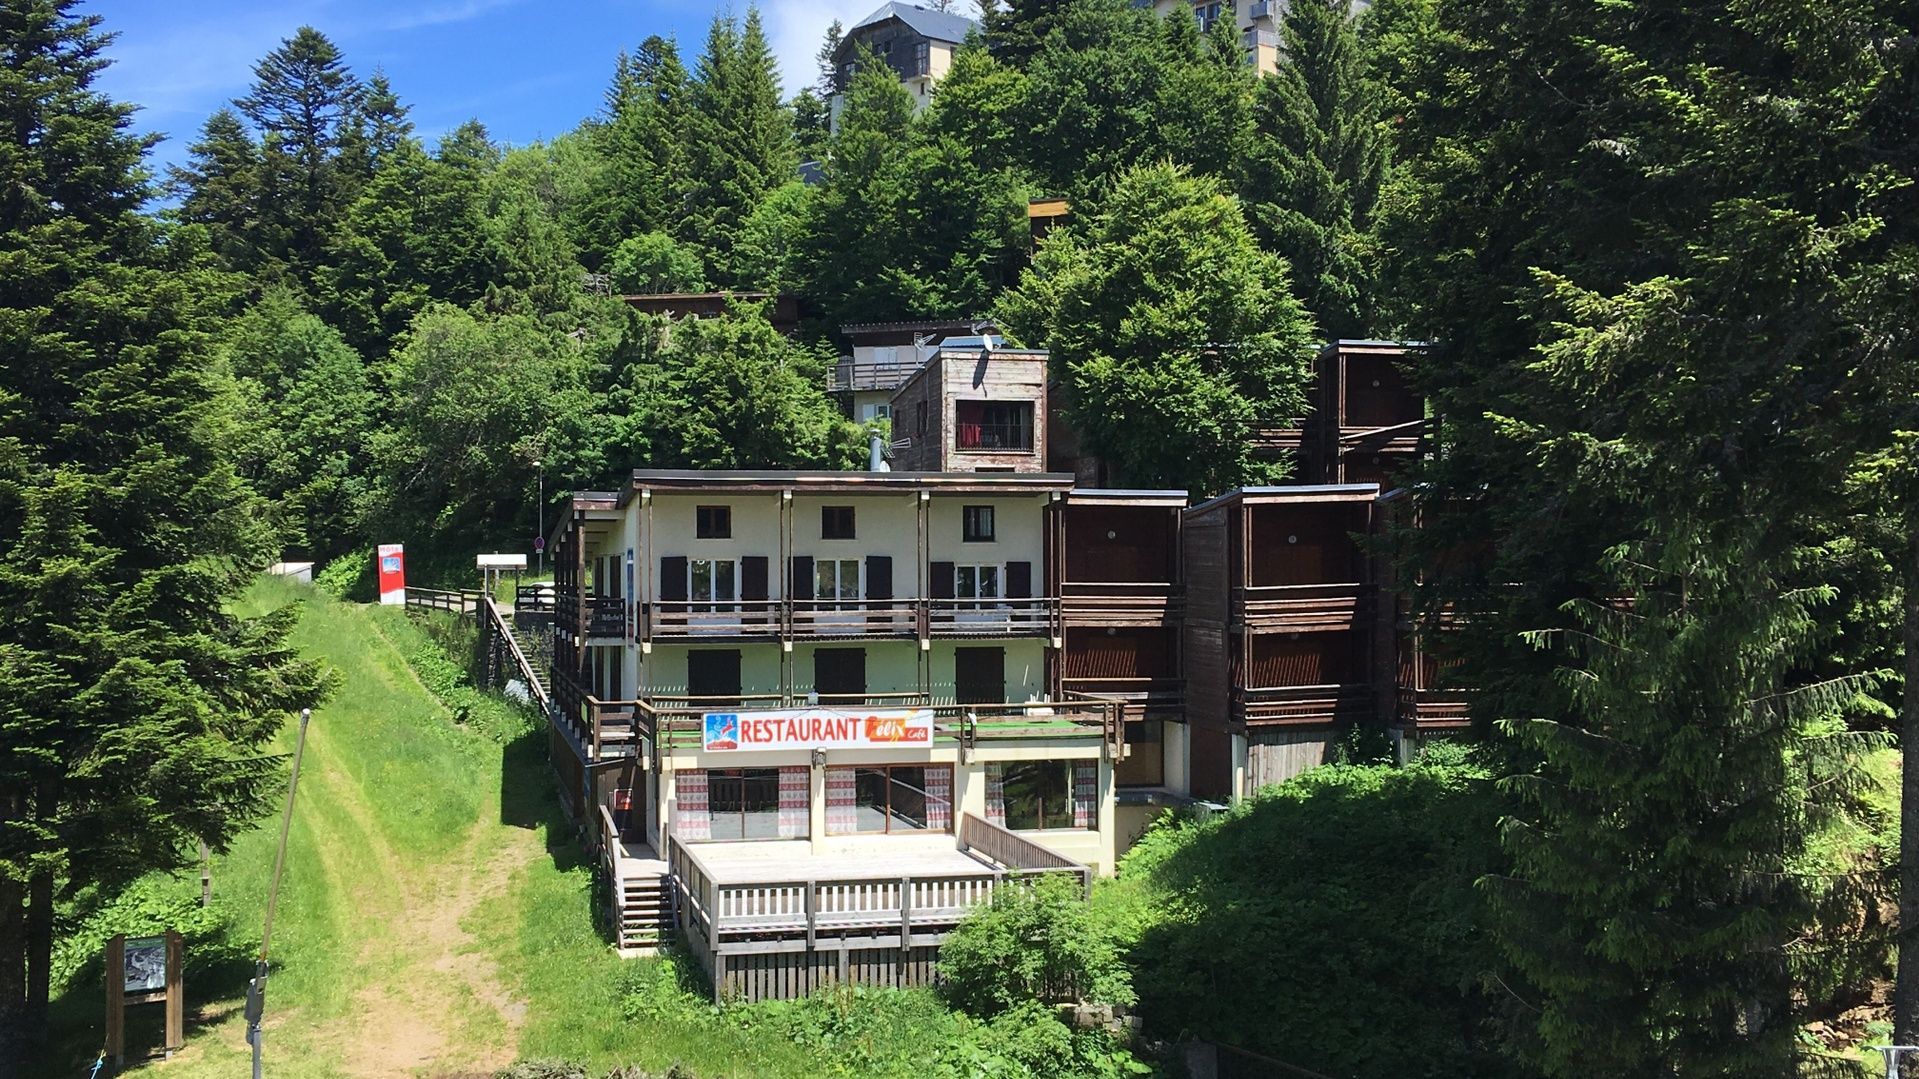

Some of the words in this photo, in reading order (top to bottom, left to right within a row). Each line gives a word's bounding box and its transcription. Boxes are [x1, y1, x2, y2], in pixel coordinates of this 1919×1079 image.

[740, 717, 861, 743] RESTAURANT
[865, 716, 906, 741] Félix
[907, 729, 927, 740] Café
